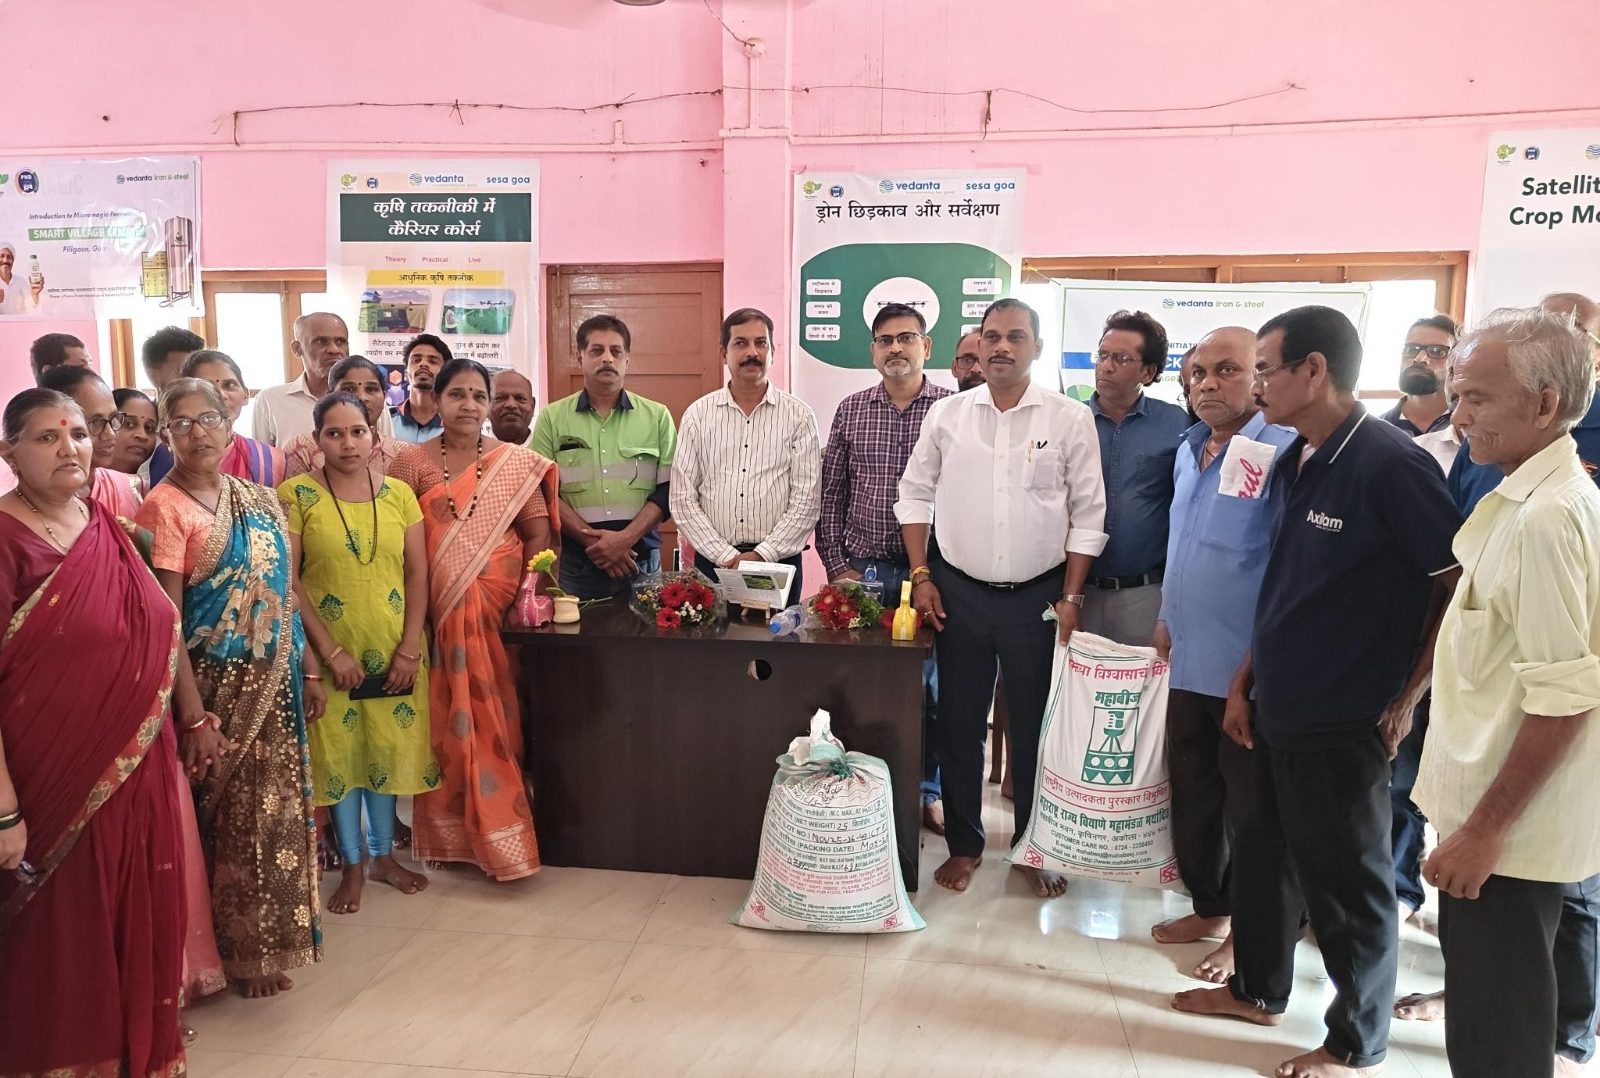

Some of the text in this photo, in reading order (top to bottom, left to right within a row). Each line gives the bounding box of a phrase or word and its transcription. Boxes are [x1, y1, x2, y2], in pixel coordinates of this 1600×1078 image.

[126, 174, 152, 182] vedanta
[424, 174, 464, 184] vedanta
[486, 176, 531, 186] sesa goa
[896, 180, 940, 190] vedanta
[966, 182, 1015, 192] sesa goa
[374, 197, 496, 218] कृषि तकनीकी में
[816, 198, 1000, 223] ड्रोन छिड़काव और सर्वेक्षण
[29, 212, 66, 220] Introduction
[1509, 206, 1563, 230] Crop
[33, 228, 66, 239] SMART
[66, 227, 105, 238] VILLAGE
[388, 220, 481, 236] कैरियर कोर्स
[385, 256, 407, 264] Theory
[399, 272, 428, 283] आधुनिक
[430, 272, 444, 285] कृषि
[1176, 300, 1214, 308] vedanta
[1216, 300, 1234, 308] iron
[1166, 342, 1198, 350] NITIAT
[1164, 356, 1183, 370] CK
[1095, 688, 1142, 707] महाबीज
[1064, 786, 1106, 806] उत्पादकता
[1108, 795, 1141, 810] पुरस्कार
[808, 819, 836, 830] WEIGHT)
[1060, 808, 1078, 824] राज्य
[1109, 816, 1144, 834] महामंडळ
[836, 822, 848, 832] 25
[1050, 829, 1081, 846] CUSTOMER
[1082, 840, 1098, 848] CARE
[1111, 832, 1137, 842] अकोला
[798, 842, 832, 853] (PACKING
[1055, 840, 1072, 851] E-mail
